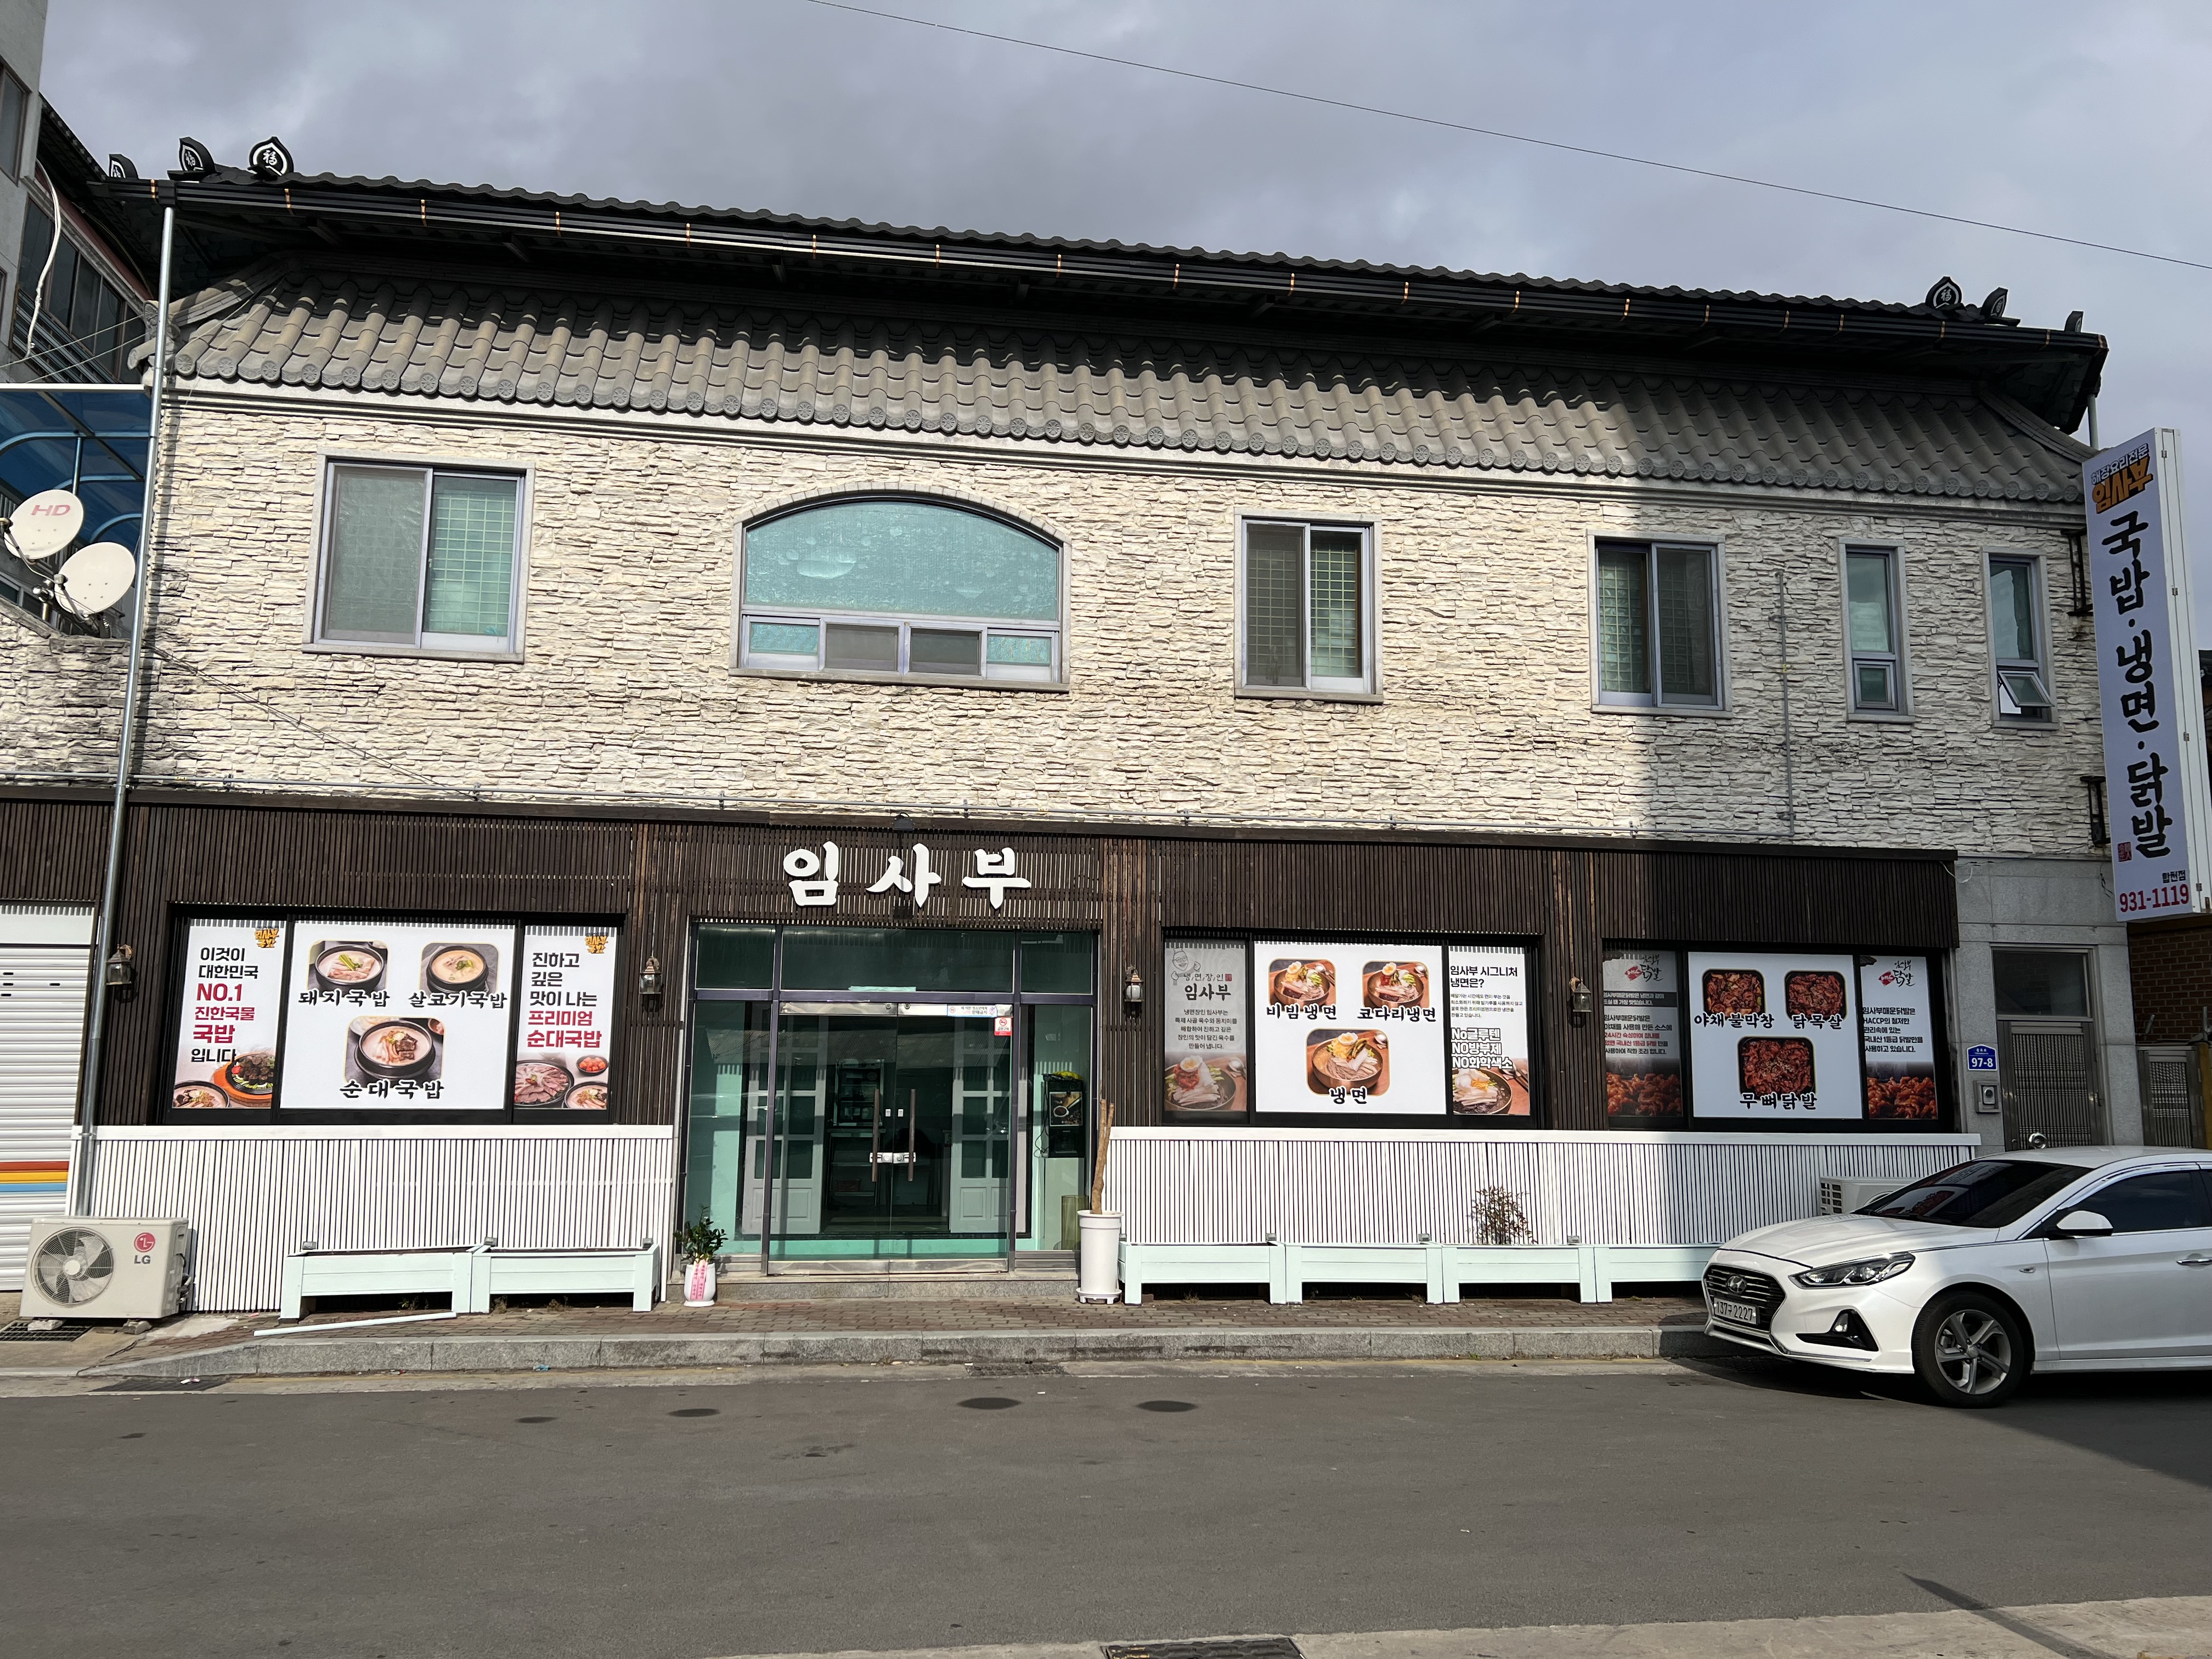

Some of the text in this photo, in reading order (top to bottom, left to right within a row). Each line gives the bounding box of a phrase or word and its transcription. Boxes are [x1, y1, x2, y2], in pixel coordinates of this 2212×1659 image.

[2091, 443, 2149, 485] 해장요리전문
[2092, 456, 2154, 514] 임사부
[31, 504, 71, 516] HD
[783, 840, 1032, 910] 임사부
[2119, 884, 2190, 912] 931-1119
[255, 929, 279, 940] 임사부
[585, 935, 608, 945] 임사부
[200, 947, 245, 961] 이것이
[532, 952, 579, 967] 진하고
[198, 964, 258, 979] 대한민국
[531, 972, 563, 987] 깊은
[1450, 966, 1518, 977] 임사부 시그니처
[1451, 978, 1485, 988] 냉면은?
[196, 983, 242, 1001] NO.1
[298, 990, 390, 1007] 돼지국밥
[408, 991, 507, 1009] 살코기국밥
[530, 991, 597, 1007] 맛이 나는
[1184, 983, 1232, 1001] 임사부
[195, 1006, 255, 1020] 진한국물
[528, 1011, 592, 1026] 프리미엄
[1266, 1003, 1337, 1020] 비빔냉면
[1357, 1006, 1436, 1022] 코다리냉면
[1863, 1007, 1916, 1015] 임사부매운닭발은
[1793, 1014, 1843, 1030] 닭목살
[193, 1024, 235, 1043] 국밥
[527, 1030, 602, 1048] 순대국밥
[1451, 1027, 1501, 1041] No글루텐
[1452, 1041, 1502, 1055] NO방부제
[1452, 1056, 1514, 1069] NO화학색소
[1971, 1058, 1993, 1067] 97-8
[340, 1079, 444, 1099] 순대국밥
[1329, 1086, 1368, 1104] 냉면
[1740, 1092, 1818, 1110] 무뼈닭발
[134, 1255, 151, 1265] LG
[1734, 1305, 1753, 1321] 2227
